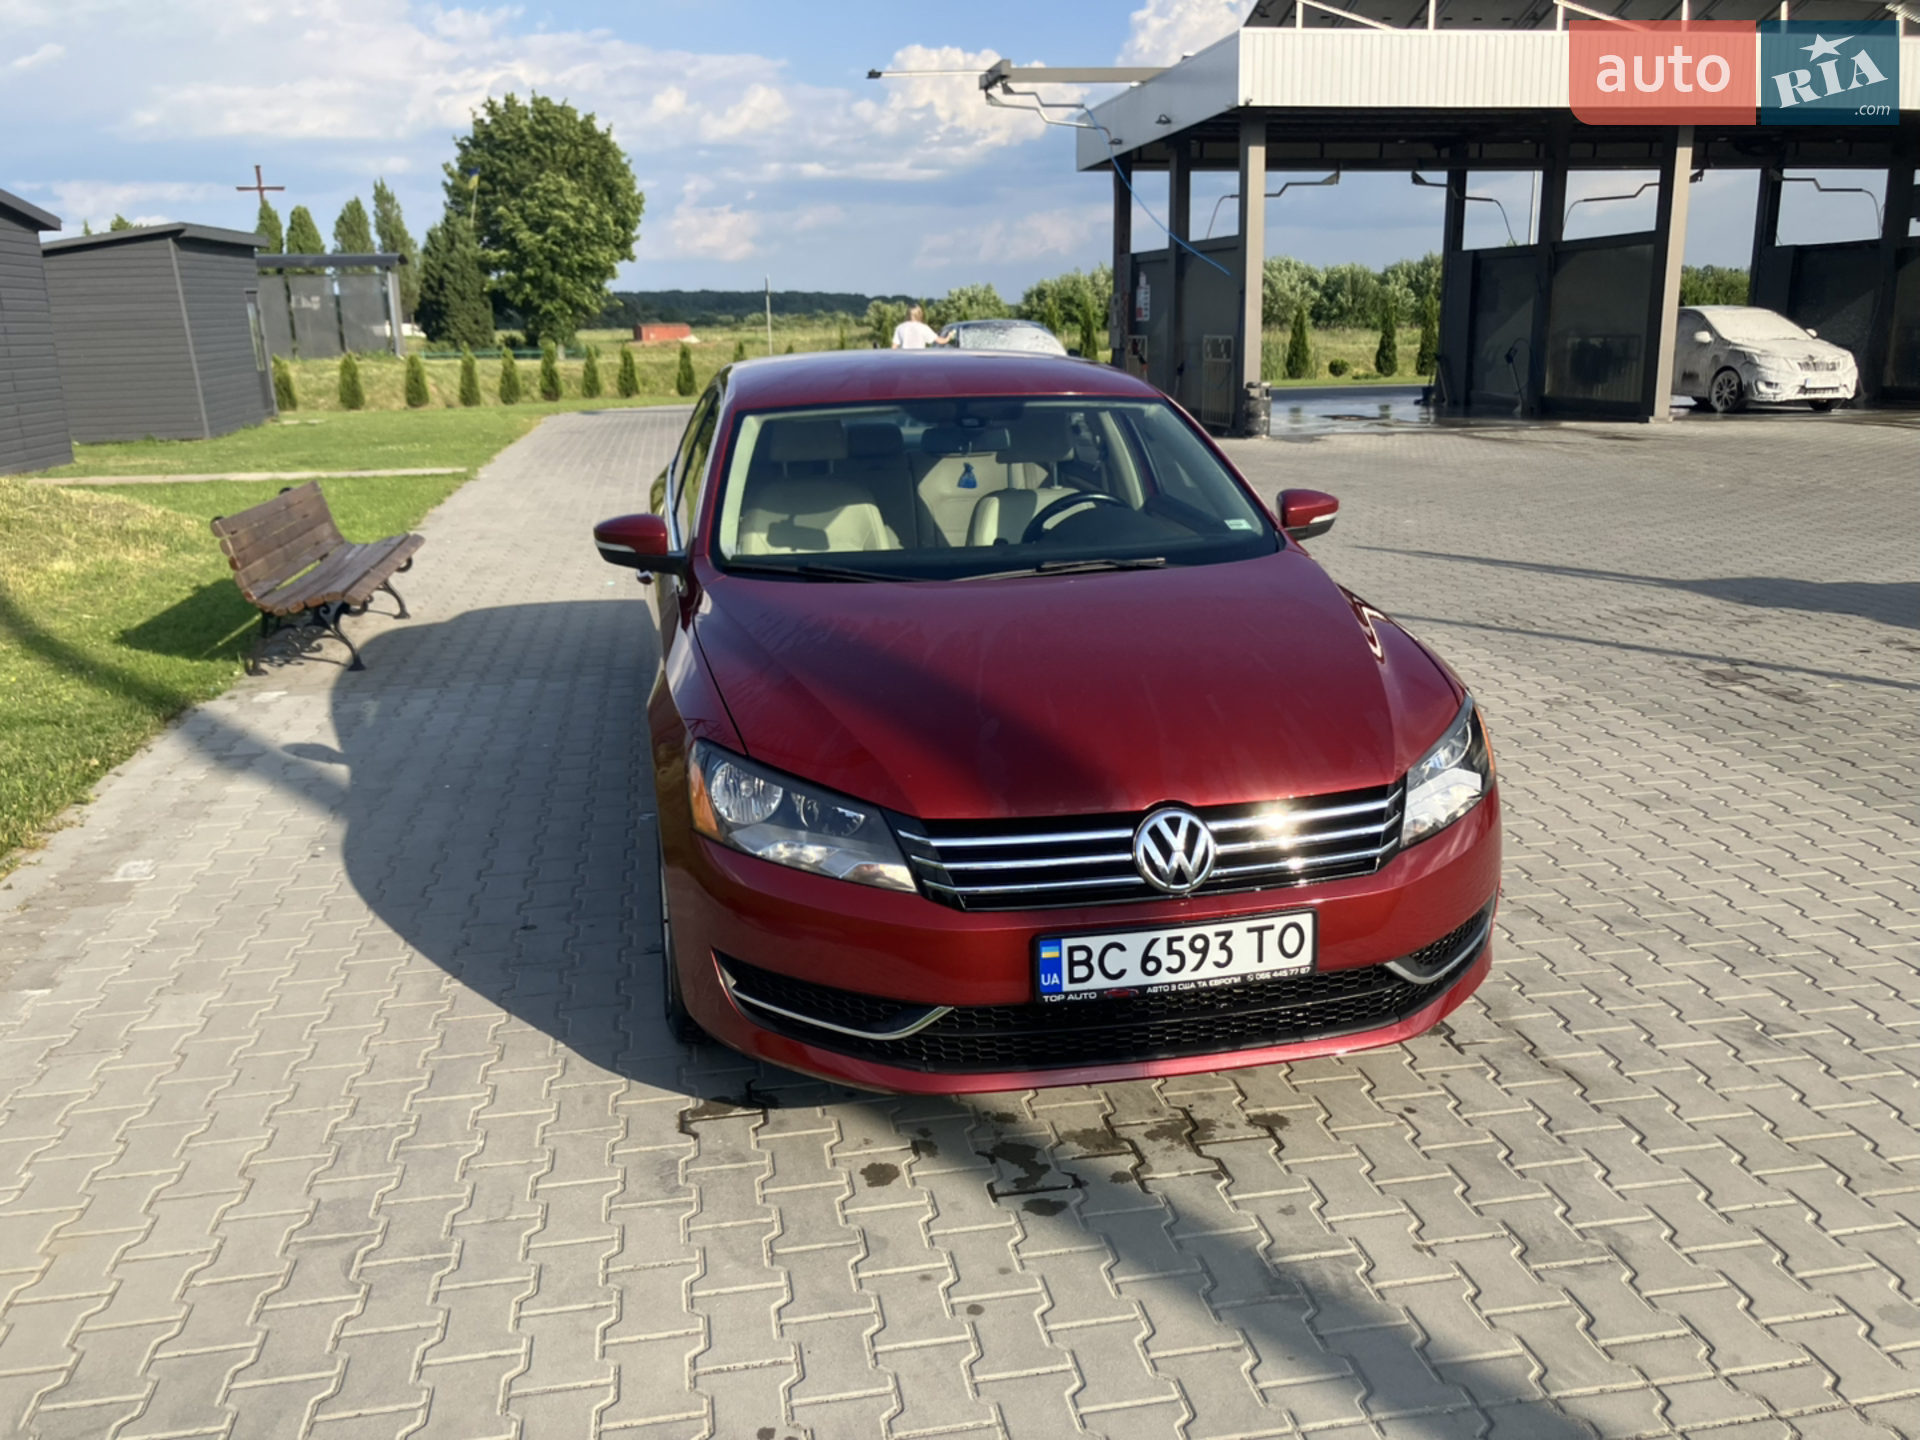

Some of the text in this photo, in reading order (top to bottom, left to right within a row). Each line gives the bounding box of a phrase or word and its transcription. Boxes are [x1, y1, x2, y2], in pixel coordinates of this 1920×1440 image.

[1067, 921, 1305, 985] BC 6593 TO
[1041, 973, 1060, 986] UA
[1042, 992, 1097, 1003] TOP AUTO
